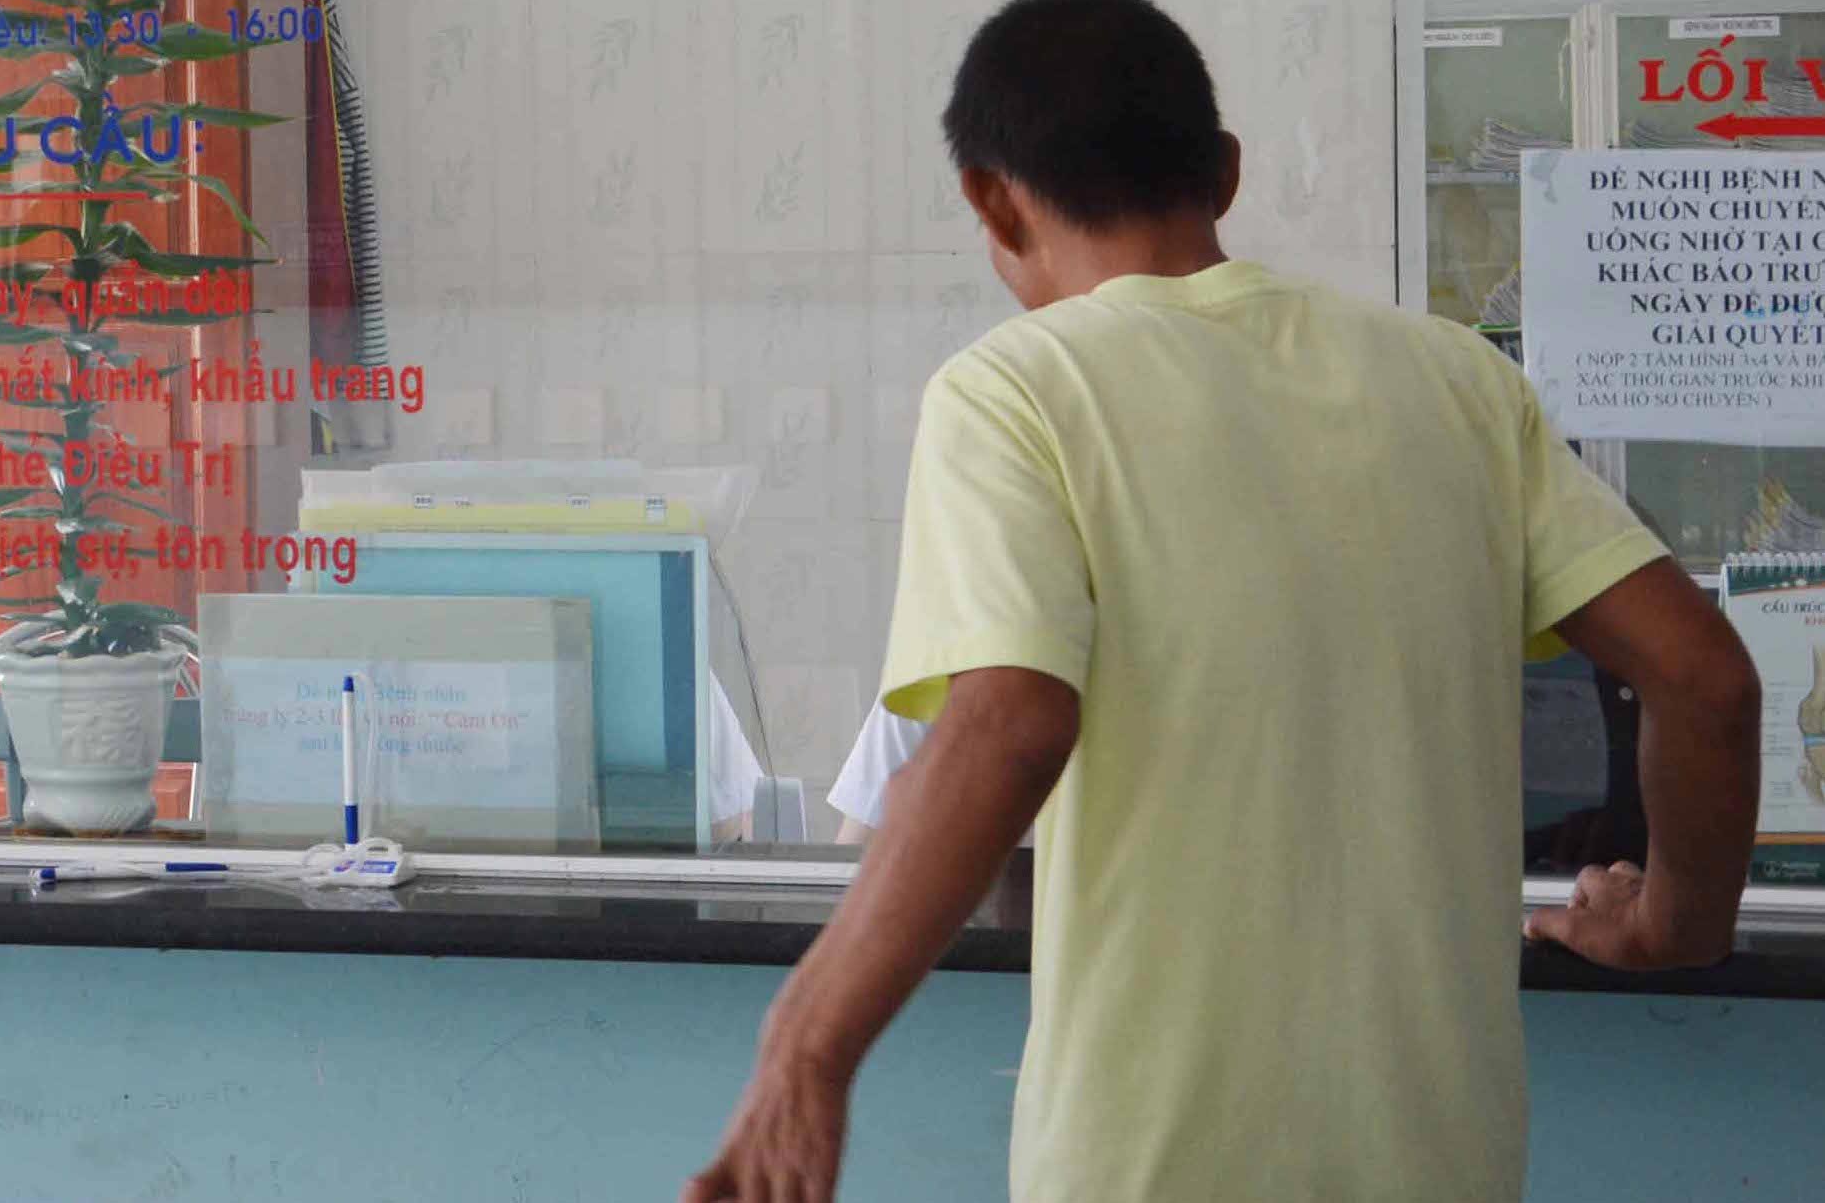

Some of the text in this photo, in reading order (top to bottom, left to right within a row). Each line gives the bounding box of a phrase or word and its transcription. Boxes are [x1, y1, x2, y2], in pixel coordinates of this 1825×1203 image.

[65, 8, 160, 46] 13:30
[227, 6, 322, 43] 16:00
[1638, 34, 1770, 103] LỐI
[40, 91, 203, 165] CẦU:
[1638, 169, 1711, 195] NGHỊ
[1721, 165, 1801, 195] BỆNH
[1752, 231, 1802, 257] TẠI
[1597, 257, 1685, 283] KHÁC
[1692, 257, 1754, 283] BÁO
[1629, 289, 1714, 314] NGÀY
[189, 339, 295, 403] khẩu
[309, 356, 424, 414] trang
[63, 431, 162, 487] Điều
[176, 440, 236, 496] Trị
[155, 524, 225, 570] tôn
[239, 526, 357, 584] trọng
